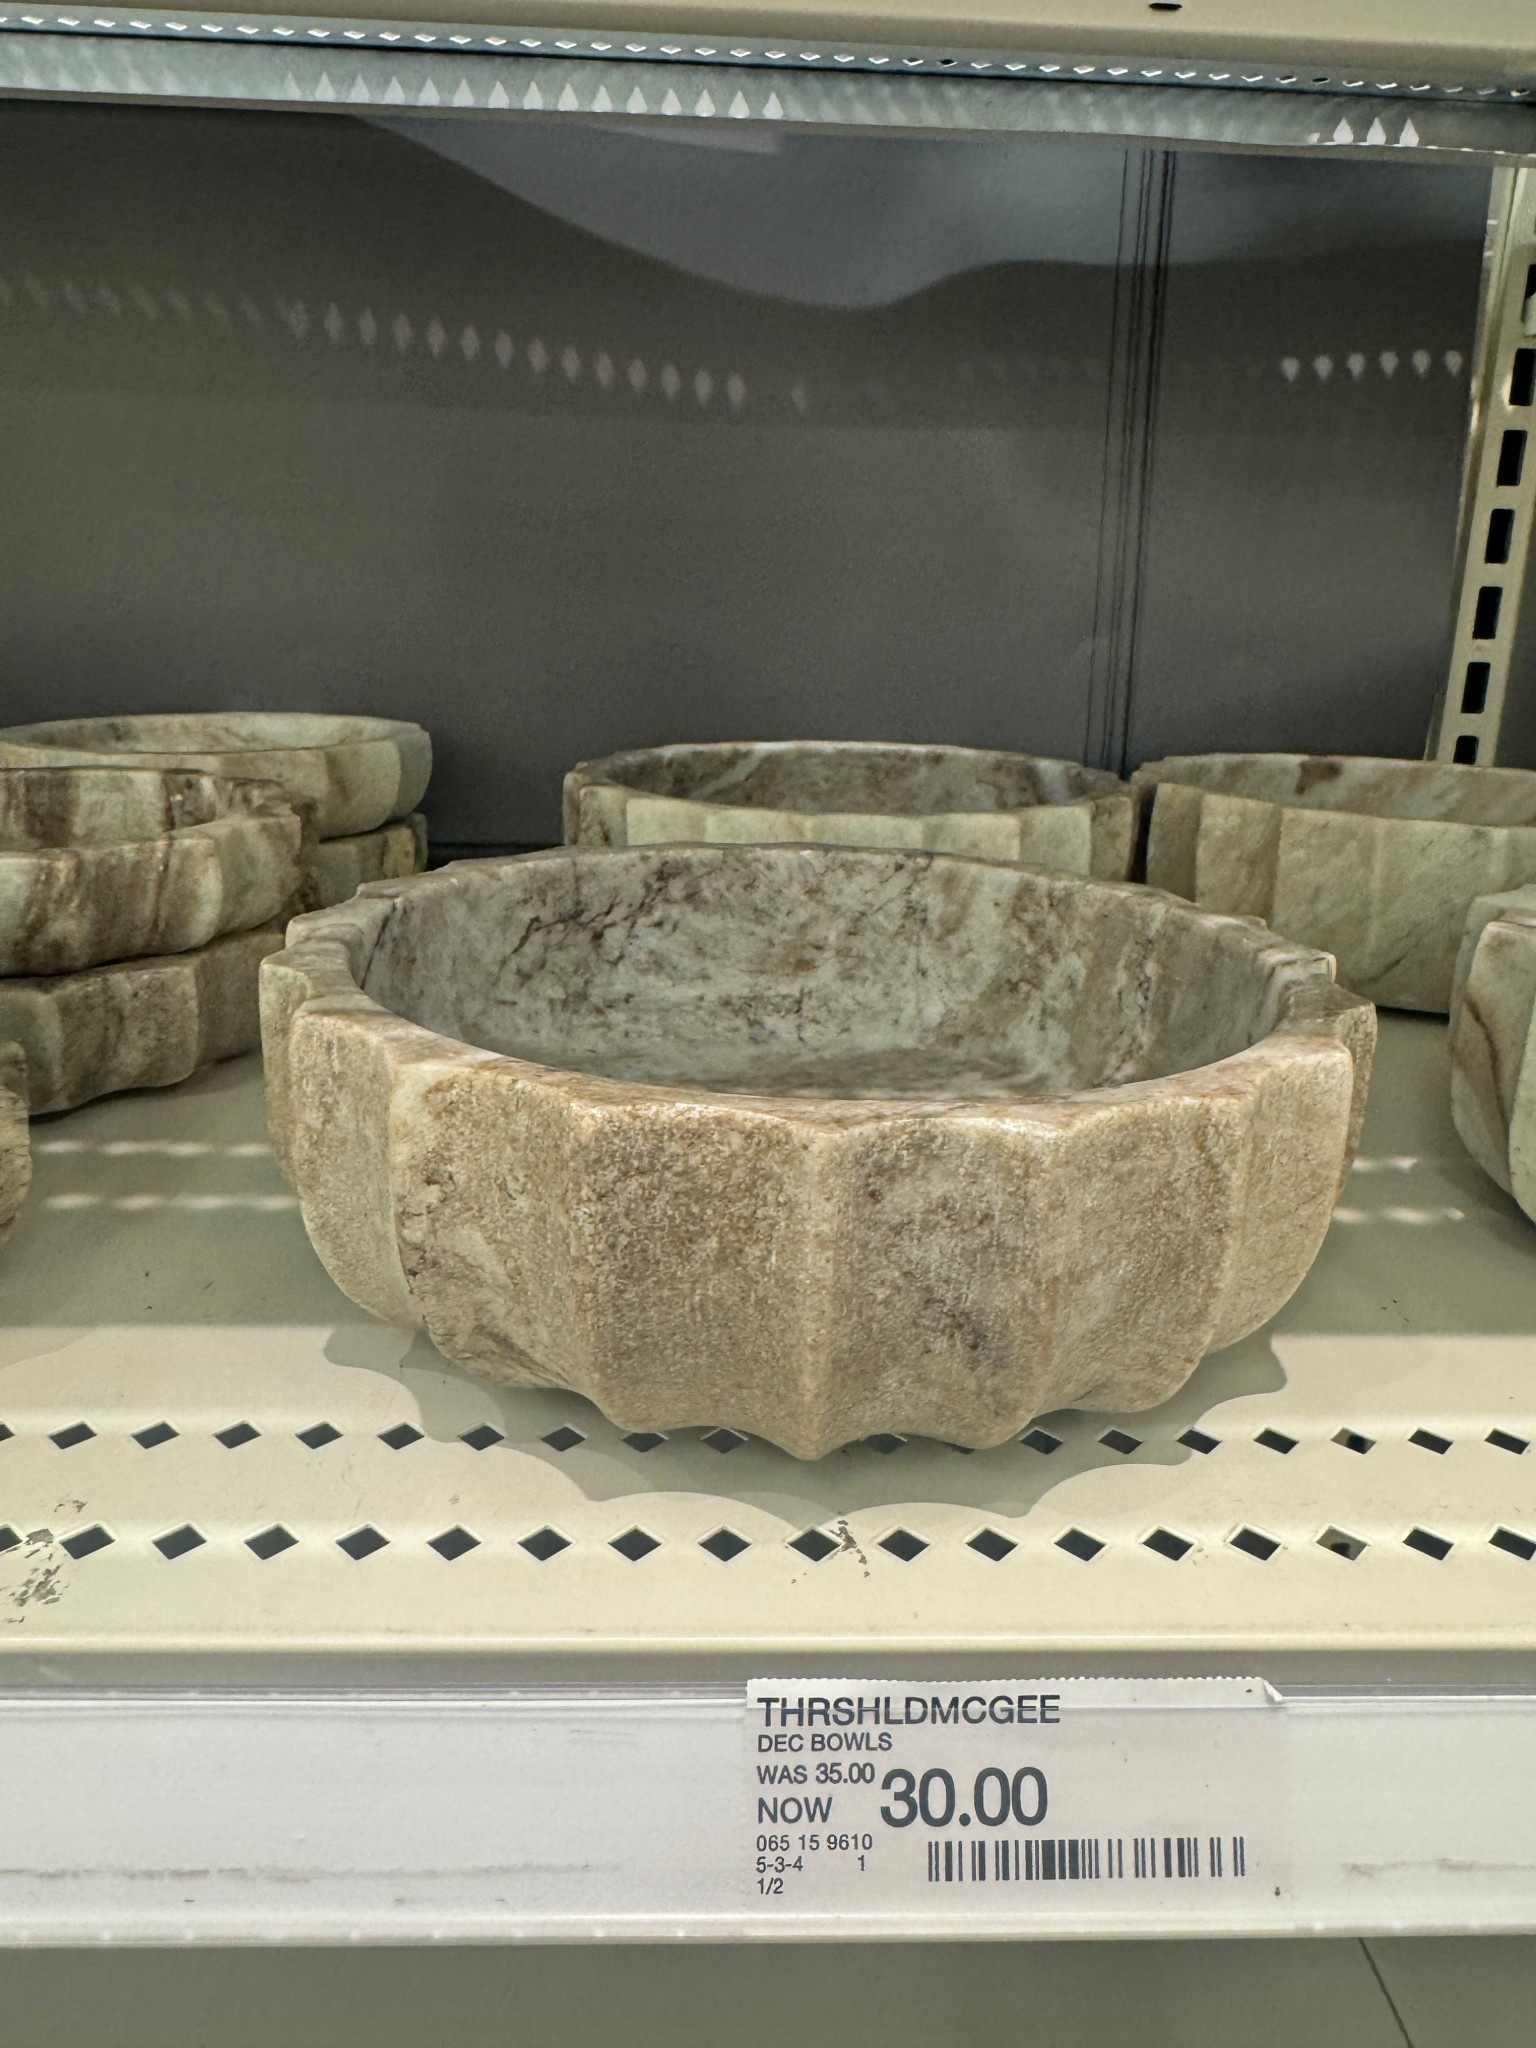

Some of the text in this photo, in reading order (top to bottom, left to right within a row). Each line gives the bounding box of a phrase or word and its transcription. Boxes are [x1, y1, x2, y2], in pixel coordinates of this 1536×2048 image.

[756, 1694, 1061, 1727] THRSHLDMCGEE
[757, 1731, 893, 1753] DEC BOWLS
[756, 1762, 876, 1785] WAS 35.00
[757, 1766, 1048, 1828] NOW 30.00
[756, 1833, 873, 1852] 065 15 9610
[755, 1854, 865, 1874] 5-3-4 1
[757, 1877, 784, 1895] 1/2
